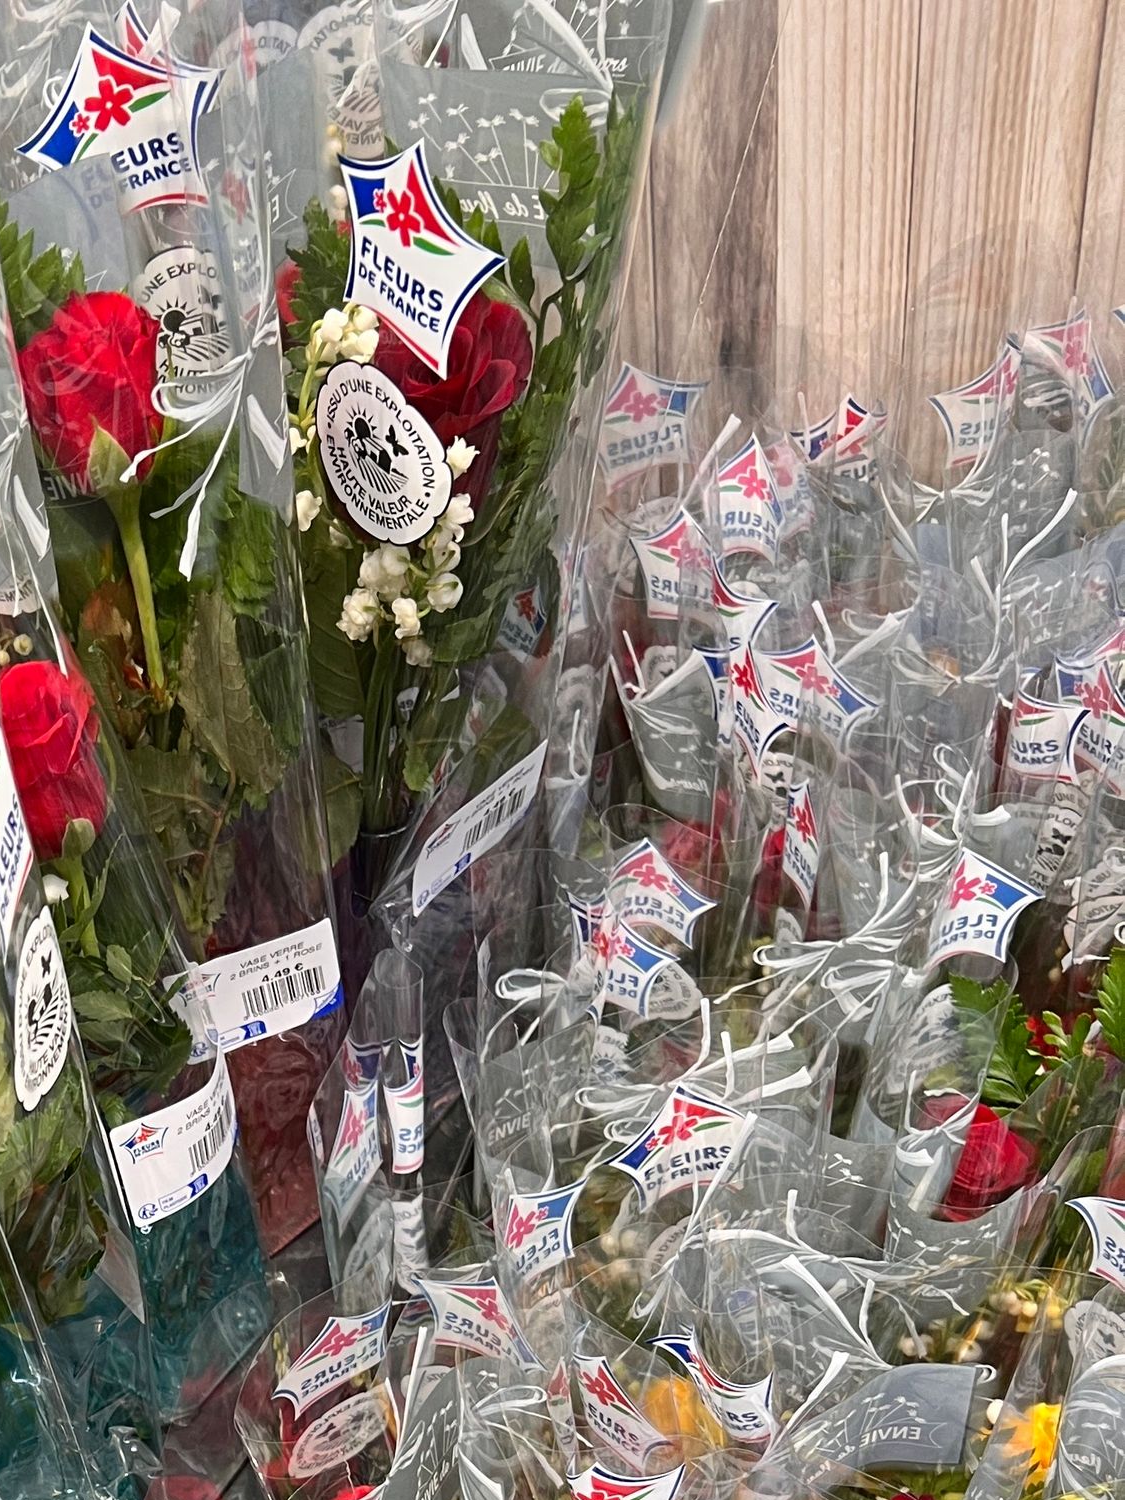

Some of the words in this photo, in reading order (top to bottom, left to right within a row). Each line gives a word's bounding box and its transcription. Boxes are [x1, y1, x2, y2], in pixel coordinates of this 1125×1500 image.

[118, 157, 192, 193] FRANCE
[361, 236, 444, 312] FLEURS
[358, 263, 376, 288] DE
[379, 282, 440, 333] FRANCE
[327, 391, 342, 423] ISSU
[340, 379, 373, 397] D'UNE
[375, 386, 435, 489] EXPLOITATION
[327, 434, 429, 530] ENVIRONNEMENTALE
[336, 446, 366, 500] HAUTE
[368, 495, 412, 516] VALEUR
[230, 973, 236, 981] 2
[238, 963, 270, 978] BRINS
[294, 943, 323, 959] ROSE
[240, 955, 267, 969] VASE
[269, 942, 305, 960] VERRE
[261, 967, 291, 983] 4.49
[294, 962, 304, 972] €
[185, 1099, 209, 1120] VASE
[177, 1128, 183, 1136] 2
[486, 1112, 532, 1146] ENVIE
[644, 1146, 732, 1181] FLEURS
